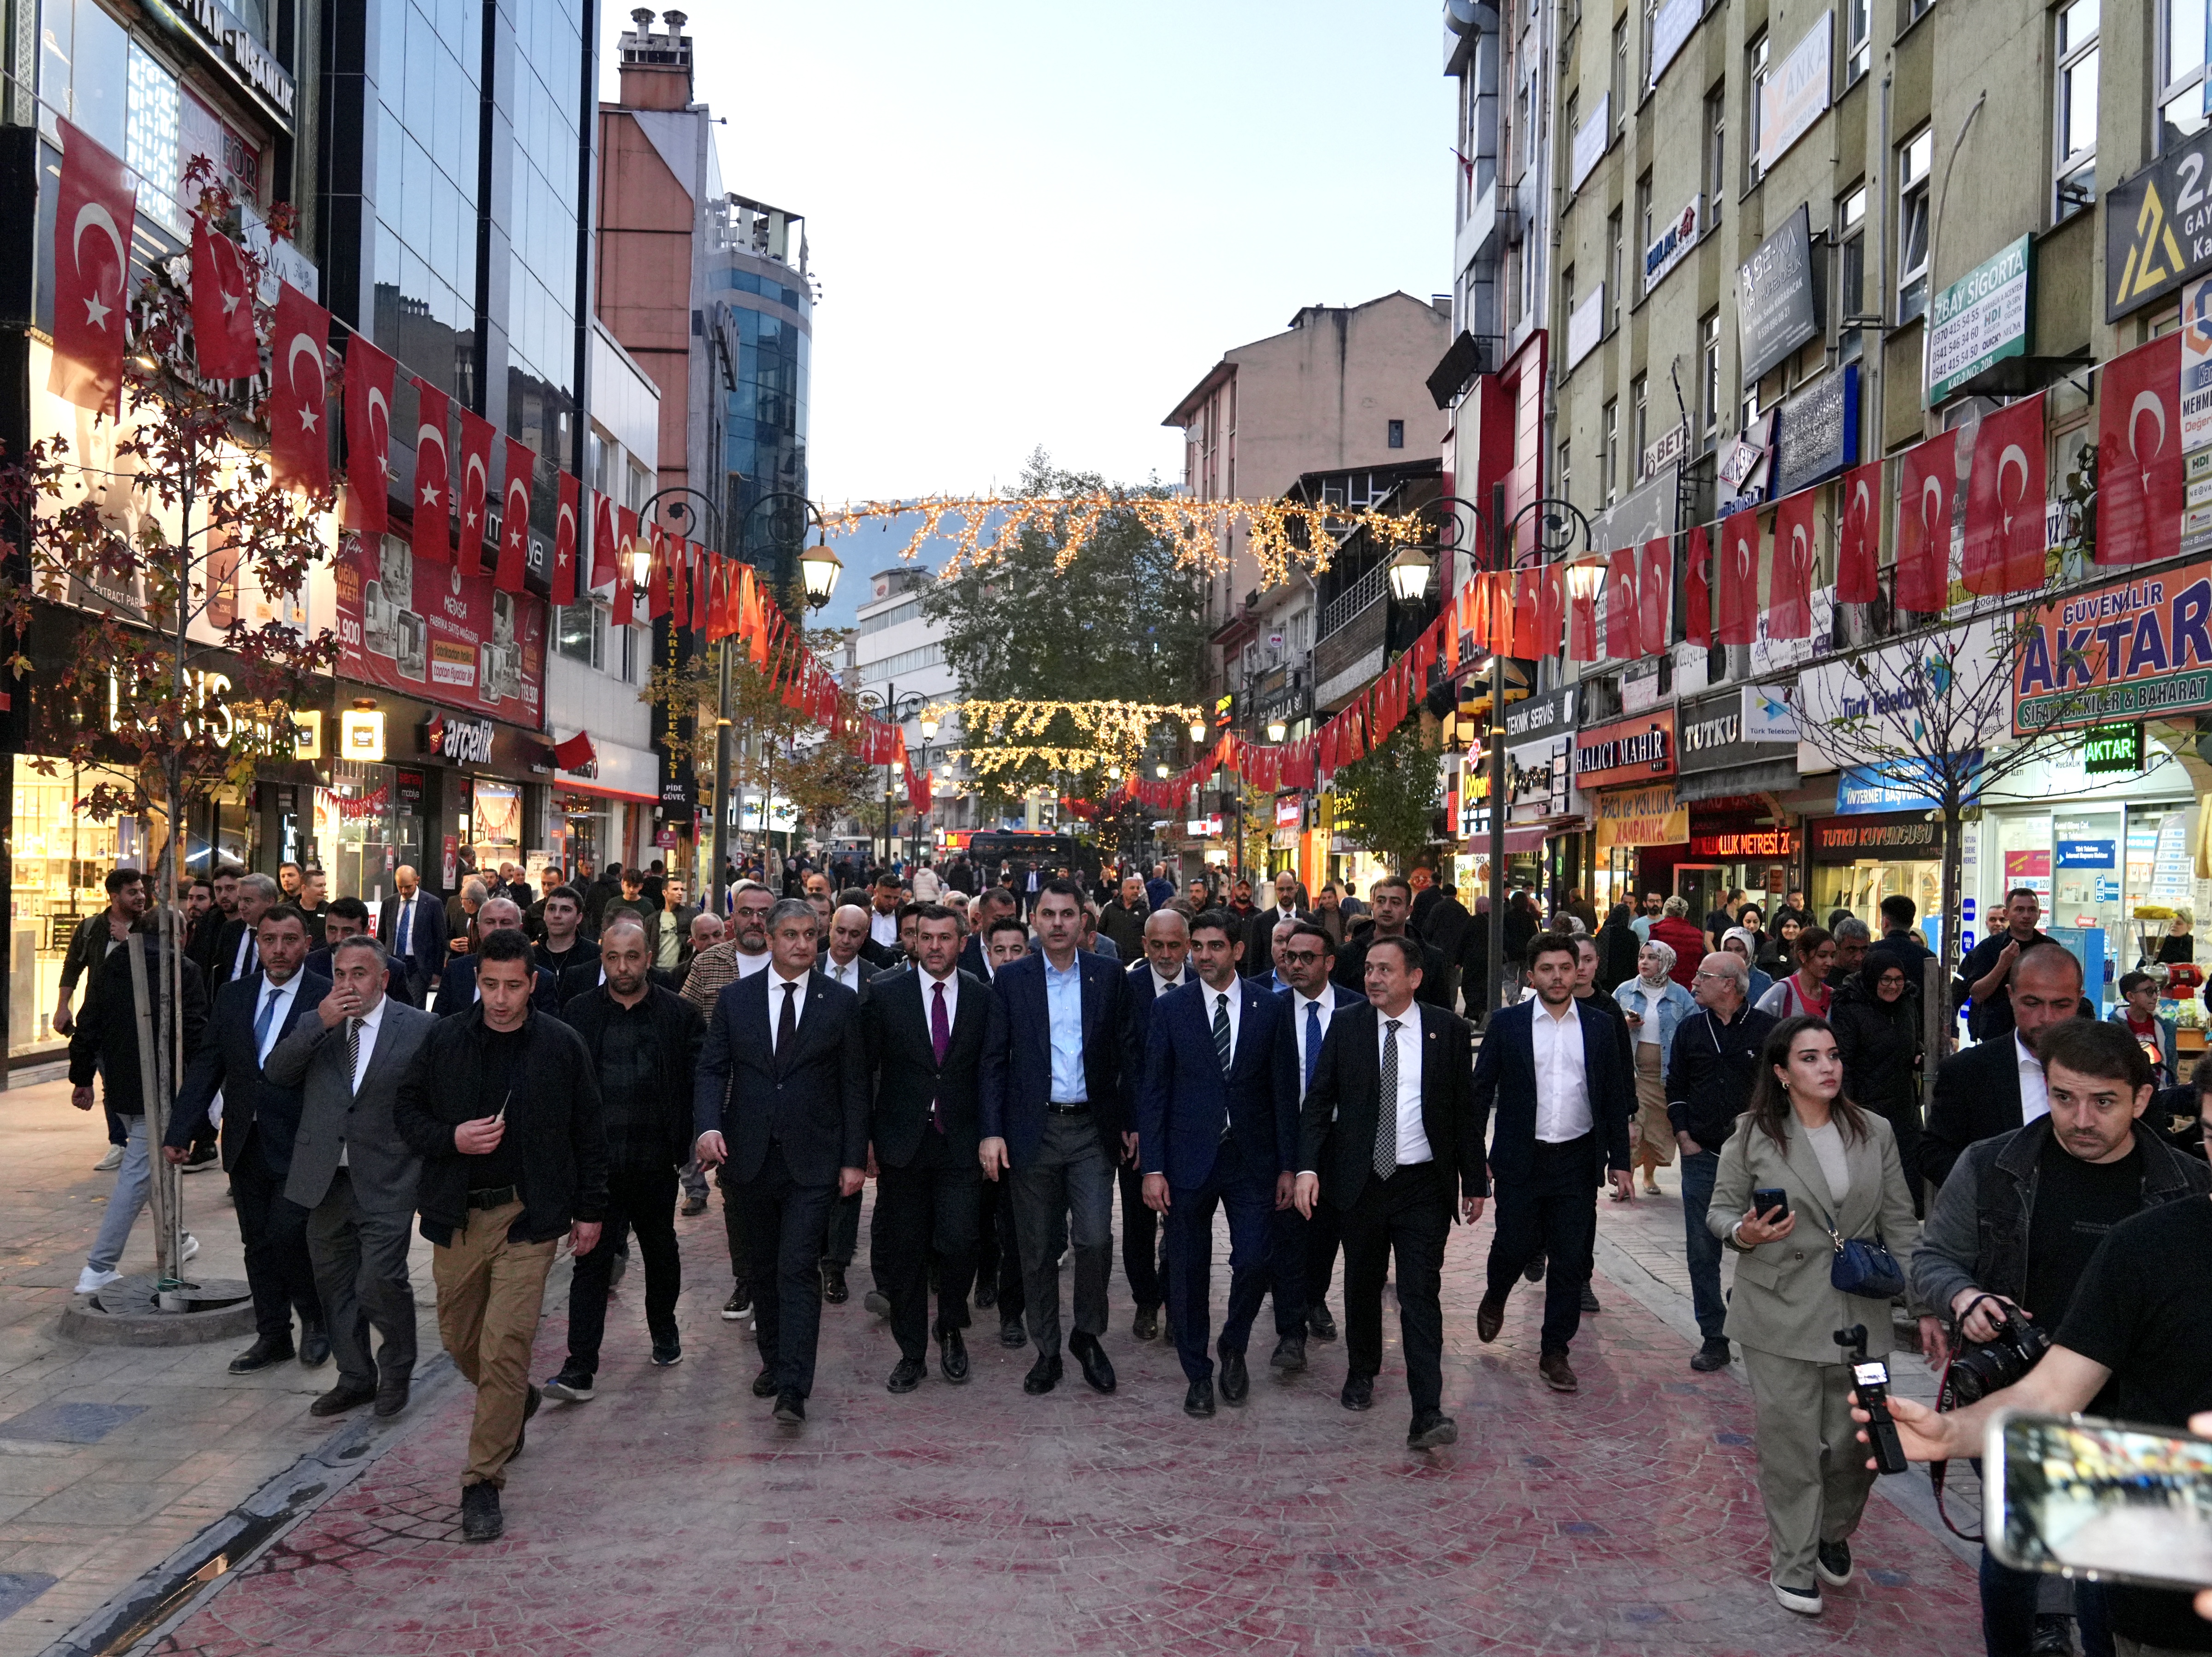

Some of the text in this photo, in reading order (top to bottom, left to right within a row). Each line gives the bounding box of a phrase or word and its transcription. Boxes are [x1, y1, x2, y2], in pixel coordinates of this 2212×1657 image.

[1743, 254, 1802, 316] YAPI MÜHENDİSLİK
[1933, 248, 2024, 326] ZBAY SİGORTA
[1764, 303, 1774, 320] Seda
[1774, 277, 1803, 310] KARABACAK
[1983, 297, 2001, 313] KARABÜK
[1933, 307, 1979, 346] 0370 415 54 55
[1984, 305, 2001, 328] HDI
[1932, 326, 1979, 364] 0541 546 34 60
[1983, 334, 2000, 351] QUICK
[1932, 343, 1978, 381] 0541 415 54 50
[1980, 355, 1993, 371] 208
[2185, 416, 2212, 433] Değer
[1657, 421, 1691, 463] BETA
[2192, 454, 2209, 470] HDI
[338, 562, 358, 588] ÜĞÜN
[94, 585, 124, 604] EXTRACT
[337, 583, 358, 604] AKETİ
[2062, 580, 2164, 625] GÜVENİLİR
[1943, 603, 1975, 619] Mhammet
[336, 615, 360, 646] 9.900
[429, 614, 479, 644] FABRİKA SATIŞ MAĞAZASI
[2019, 577, 2212, 695] AKTAR
[521, 682, 538, 705] 119.900
[2124, 692, 2135, 707] &
[2138, 676, 2208, 706] BAHARAT
[1507, 698, 1554, 737] TEKNİK SERVİS
[445, 720, 495, 767] arçelik
[1684, 714, 1738, 752] TUTKU
[1576, 723, 1663, 773] HALICI MAHİR
[2085, 738, 2132, 762] AKTAR
[663, 792, 686, 803] GÜVEÇ
[665, 783, 683, 792] PİDE
[1847, 786, 1883, 805] İNTERNET
[1741, 828, 1778, 855] METRESİ
[1823, 823, 1934, 847] TUTKU KUYUMCUSU
[1963, 855, 1977, 864] MERKEZİ
[2013, 879, 2018, 889] 5
[2039, 879, 2050, 889] 120
[2039, 898, 2049, 907] 150
[2039, 917, 2048, 926] 195
